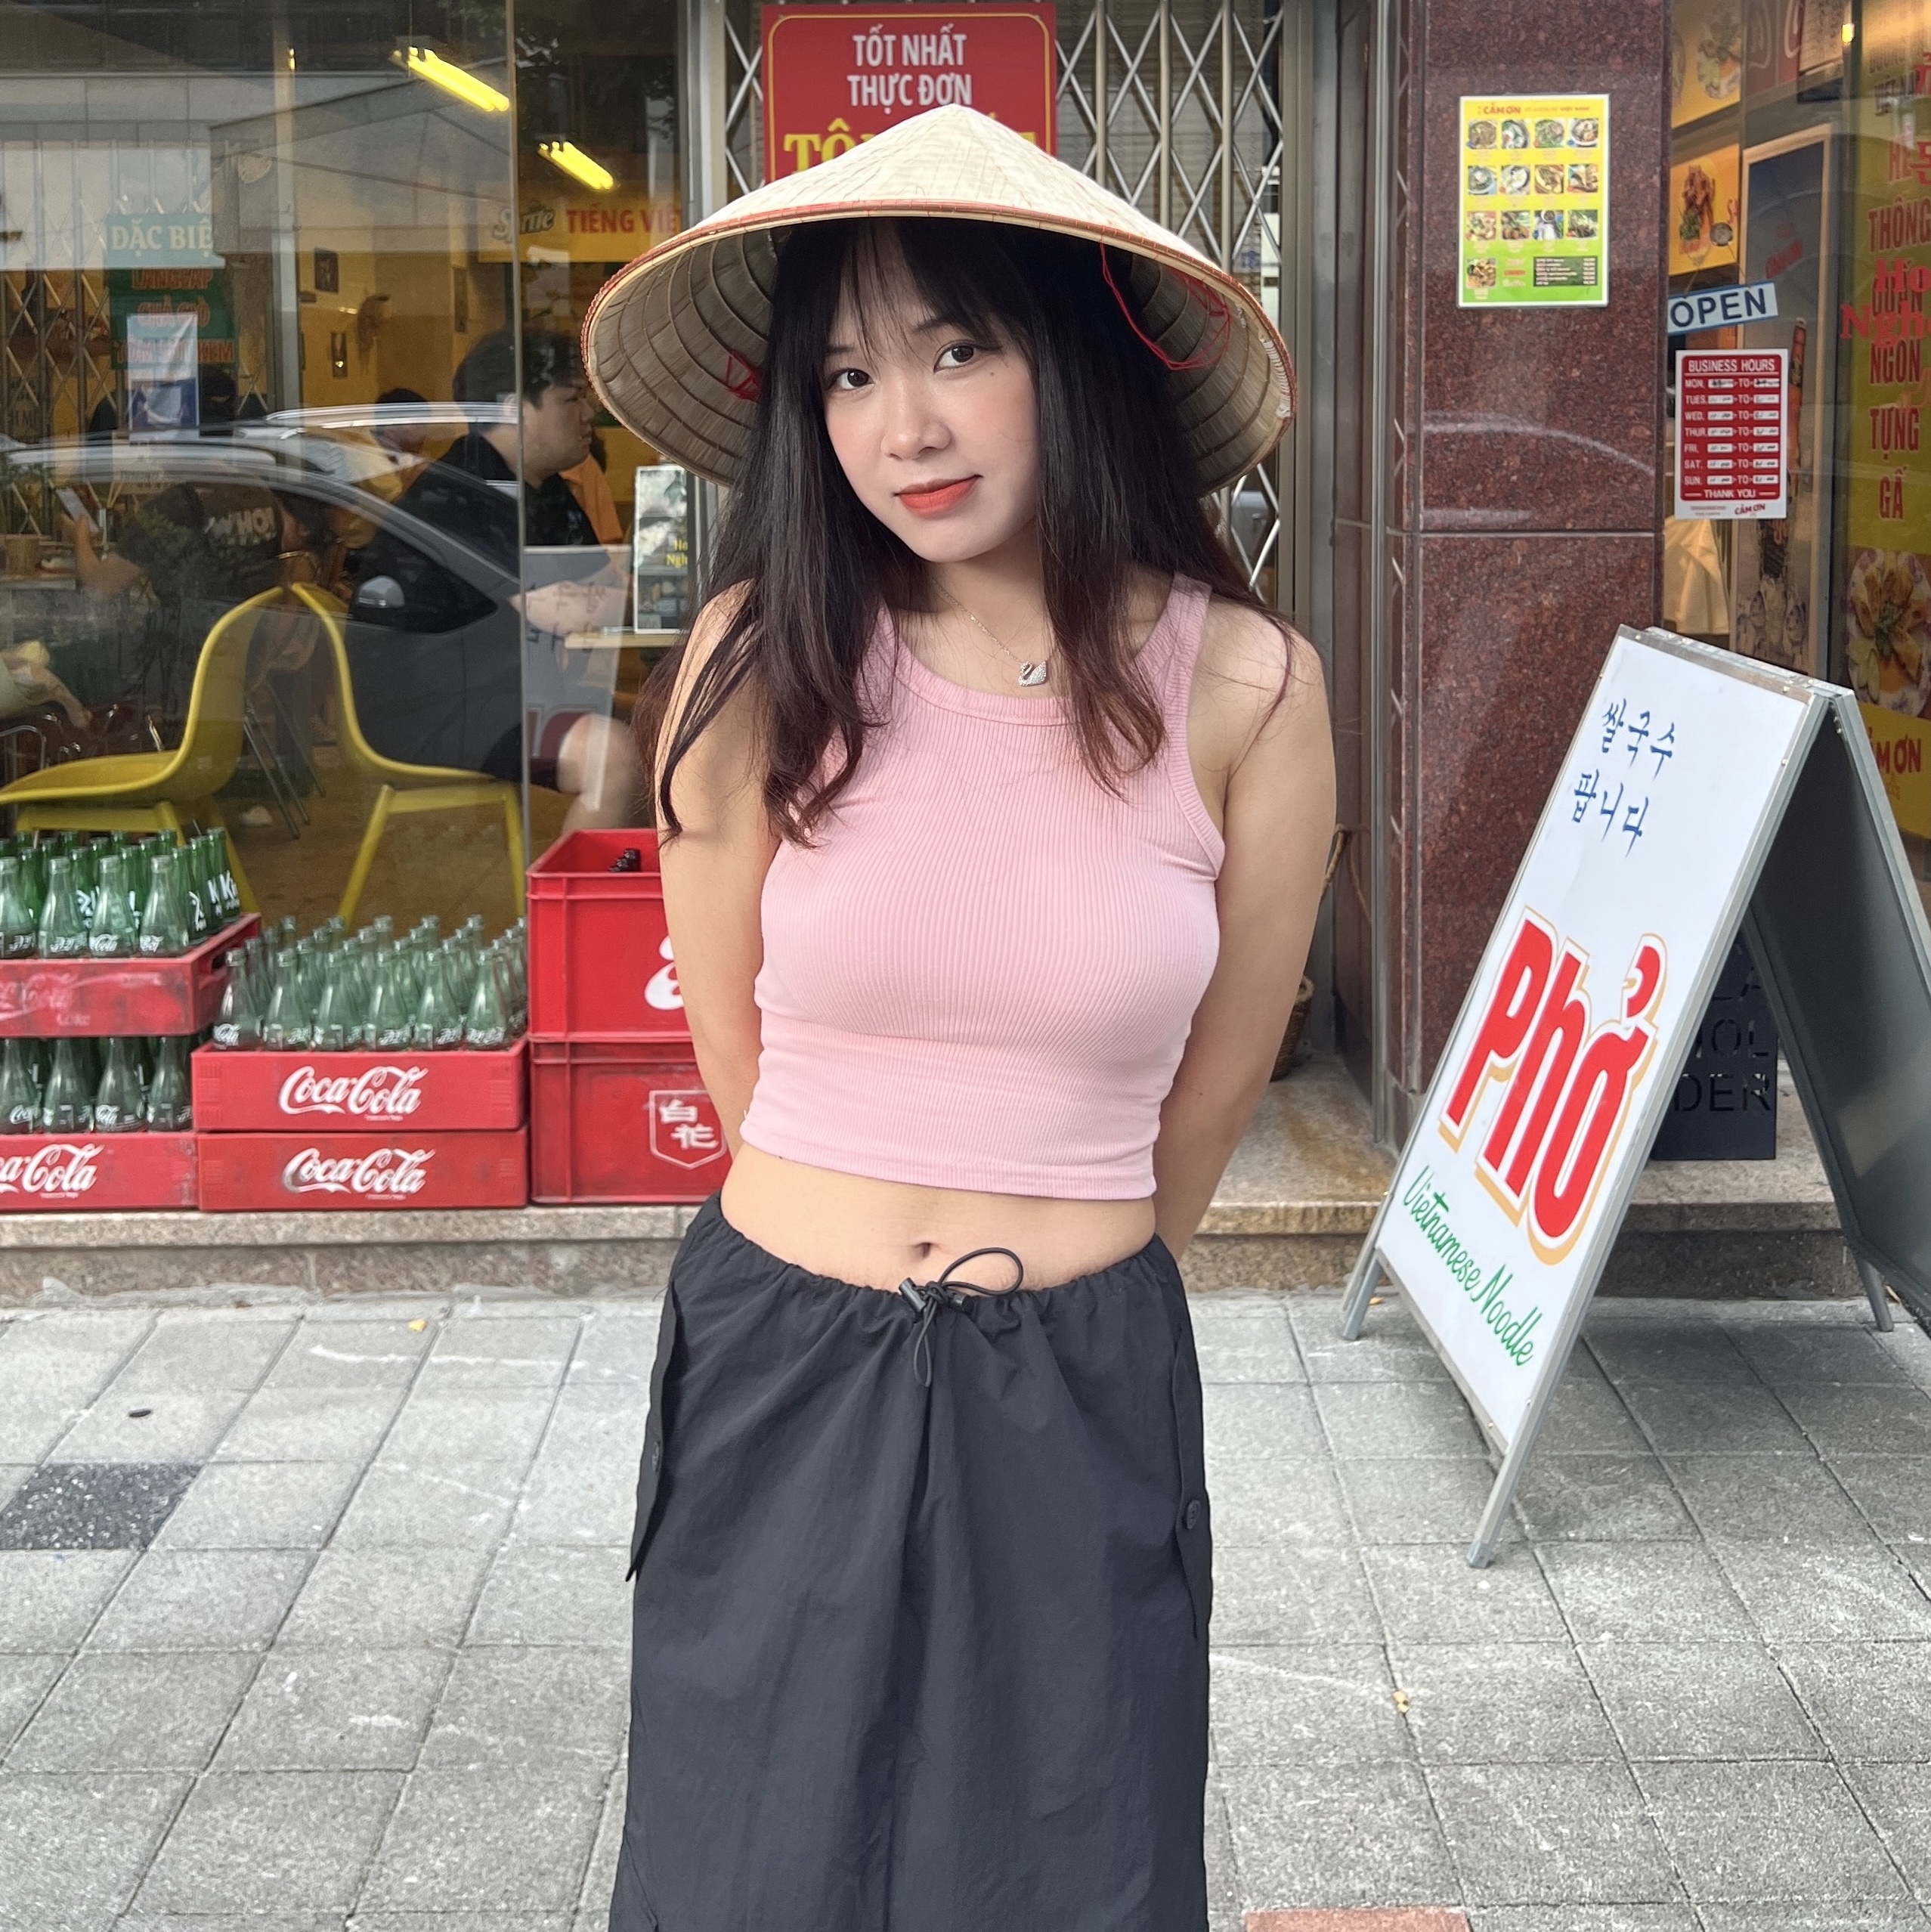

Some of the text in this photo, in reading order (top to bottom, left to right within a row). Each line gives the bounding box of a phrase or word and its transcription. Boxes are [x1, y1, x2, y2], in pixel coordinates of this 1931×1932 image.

[852, 23, 967, 67] TỐT NHẤT
[846, 72, 973, 115] THỰC ĐƠN
[565, 203, 635, 235] TIẾNG
[1670, 287, 1767, 328] OPEN
[1688, 358, 1775, 372] BUSINESS HOURS
[1738, 394, 1750, 404] TO
[1739, 378, 1750, 388] TO
[1738, 410, 1750, 420] TO
[1738, 426, 1750, 435] TO
[1738, 443, 1749, 452] TO
[1738, 459, 1749, 468] TO
[1704, 488, 1756, 498] THANK YOU
[1737, 475, 1749, 485] TO
[1601, 698, 1675, 781] 쌀국수
[1572, 769, 1648, 857] 팝니다
[278, 1066, 429, 1115] Coca-Cola
[1441, 909, 1665, 1253] Phở
[282, 1147, 437, 1194] Coca-Cola
[1403, 1164, 1543, 1367] Vietnamese Noodle
